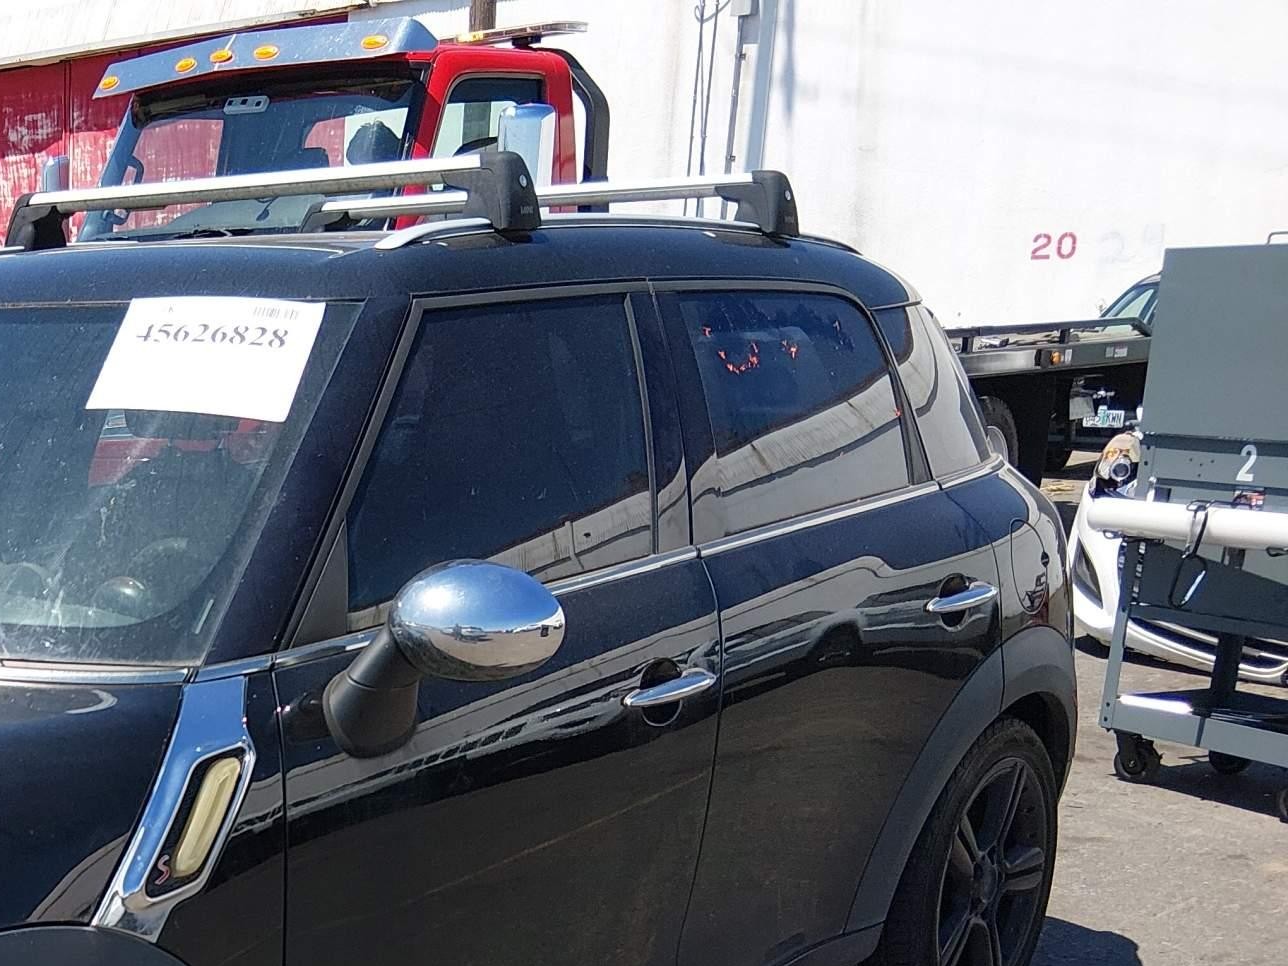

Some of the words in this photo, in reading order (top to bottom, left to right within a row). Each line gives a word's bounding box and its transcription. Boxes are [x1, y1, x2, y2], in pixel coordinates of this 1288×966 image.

[1030, 231, 1078, 260] 20
[136, 323, 289, 348] 45626828
[1235, 444, 1258, 482] 2
[154, 854, 171, 886] S
